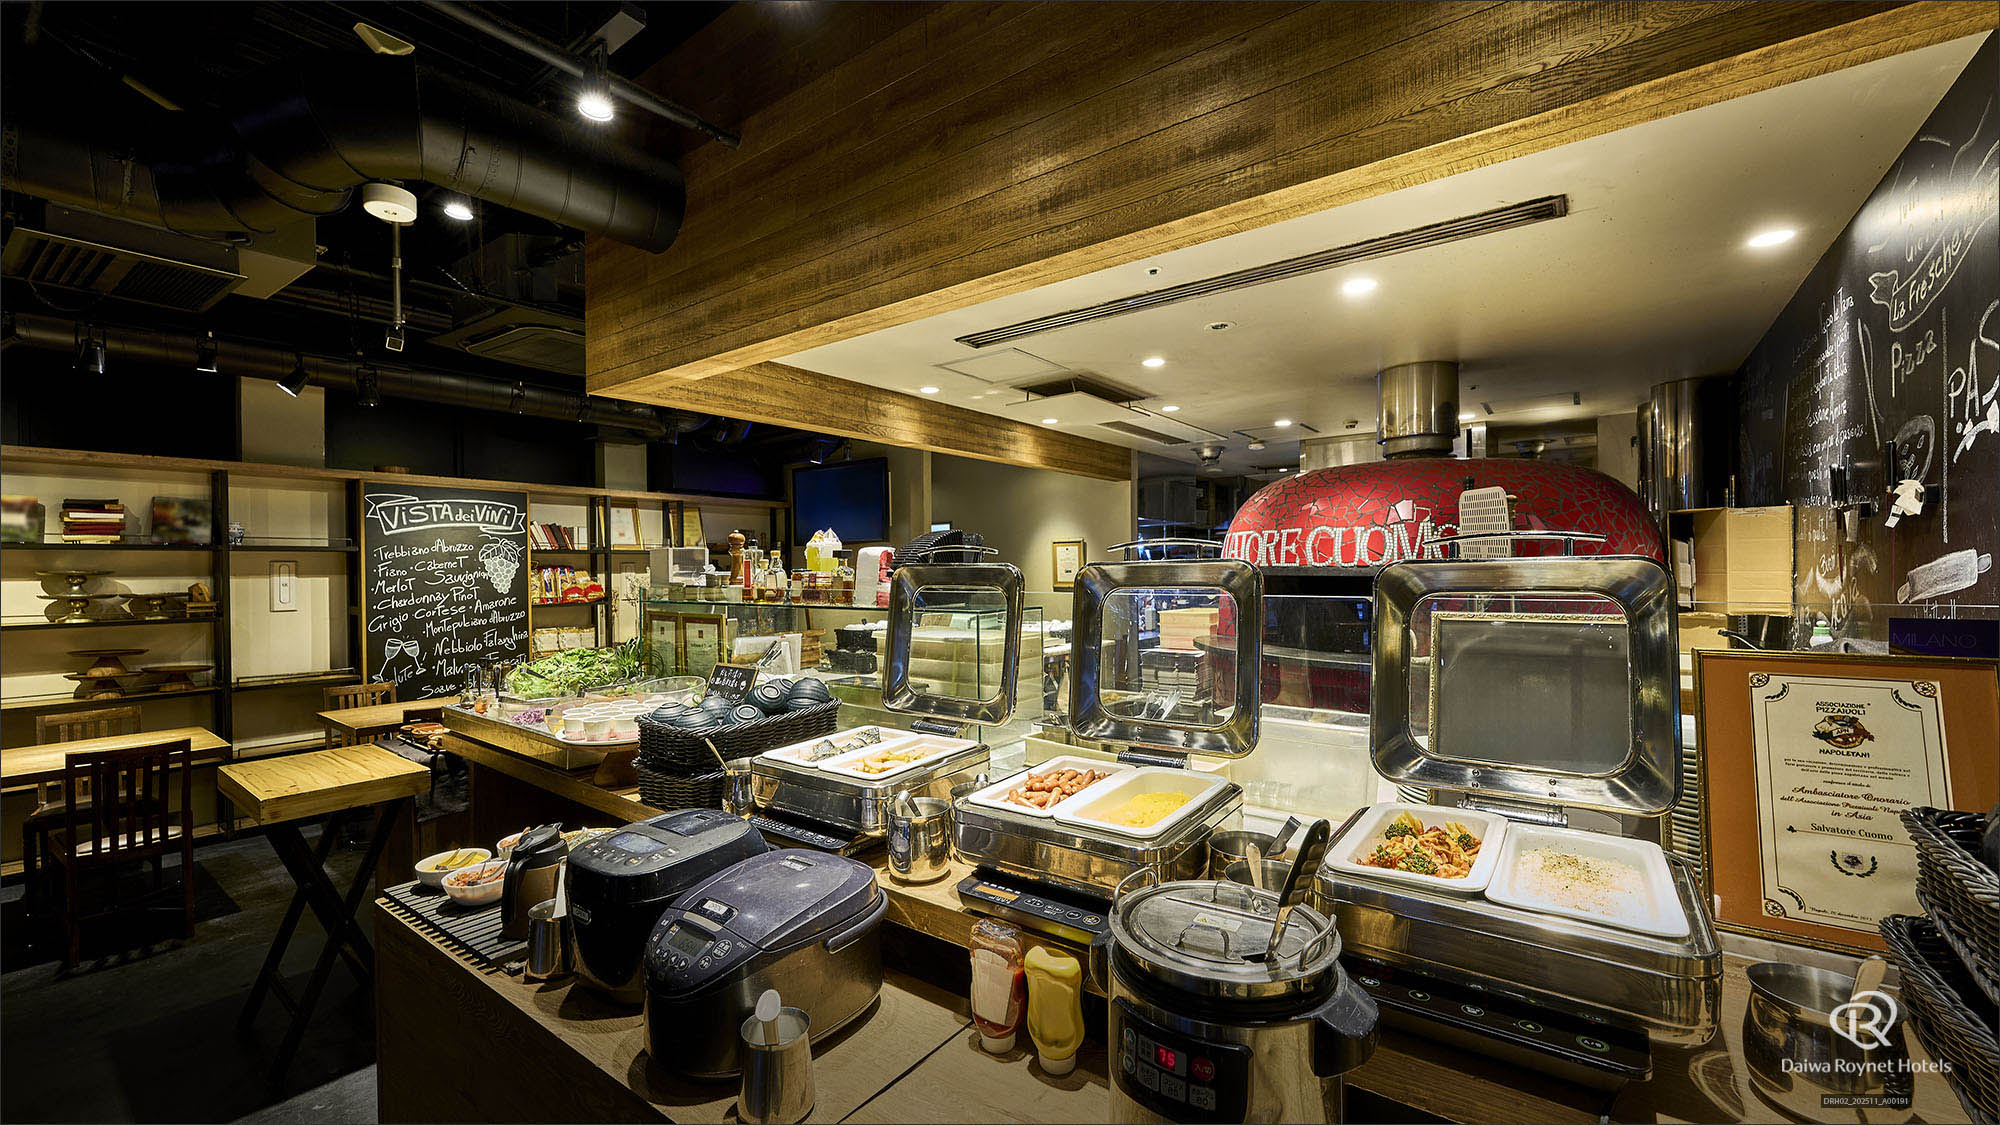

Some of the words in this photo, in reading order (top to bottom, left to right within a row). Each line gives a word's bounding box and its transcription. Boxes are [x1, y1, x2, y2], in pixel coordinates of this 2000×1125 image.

[1891, 330, 1938, 398] Pizza
[1221, 527, 1302, 567] ATORE
[379, 561, 408, 577] Fiano
[1891, 631, 1977, 650] MILANO
[1816, 701, 1866, 710] ASSOCIAZIONE
[1816, 707, 1866, 716] PIZZAIUOLI
[1819, 749, 1870, 758] NAPOLETANI
[1791, 786, 1861, 801] Ambasciatore
[1861, 792, 1912, 806] Onorario
[1844, 810, 1874, 821] Asia
[1811, 823, 1857, 837] Salvatore
[1858, 829, 1894, 842] Cuomo
